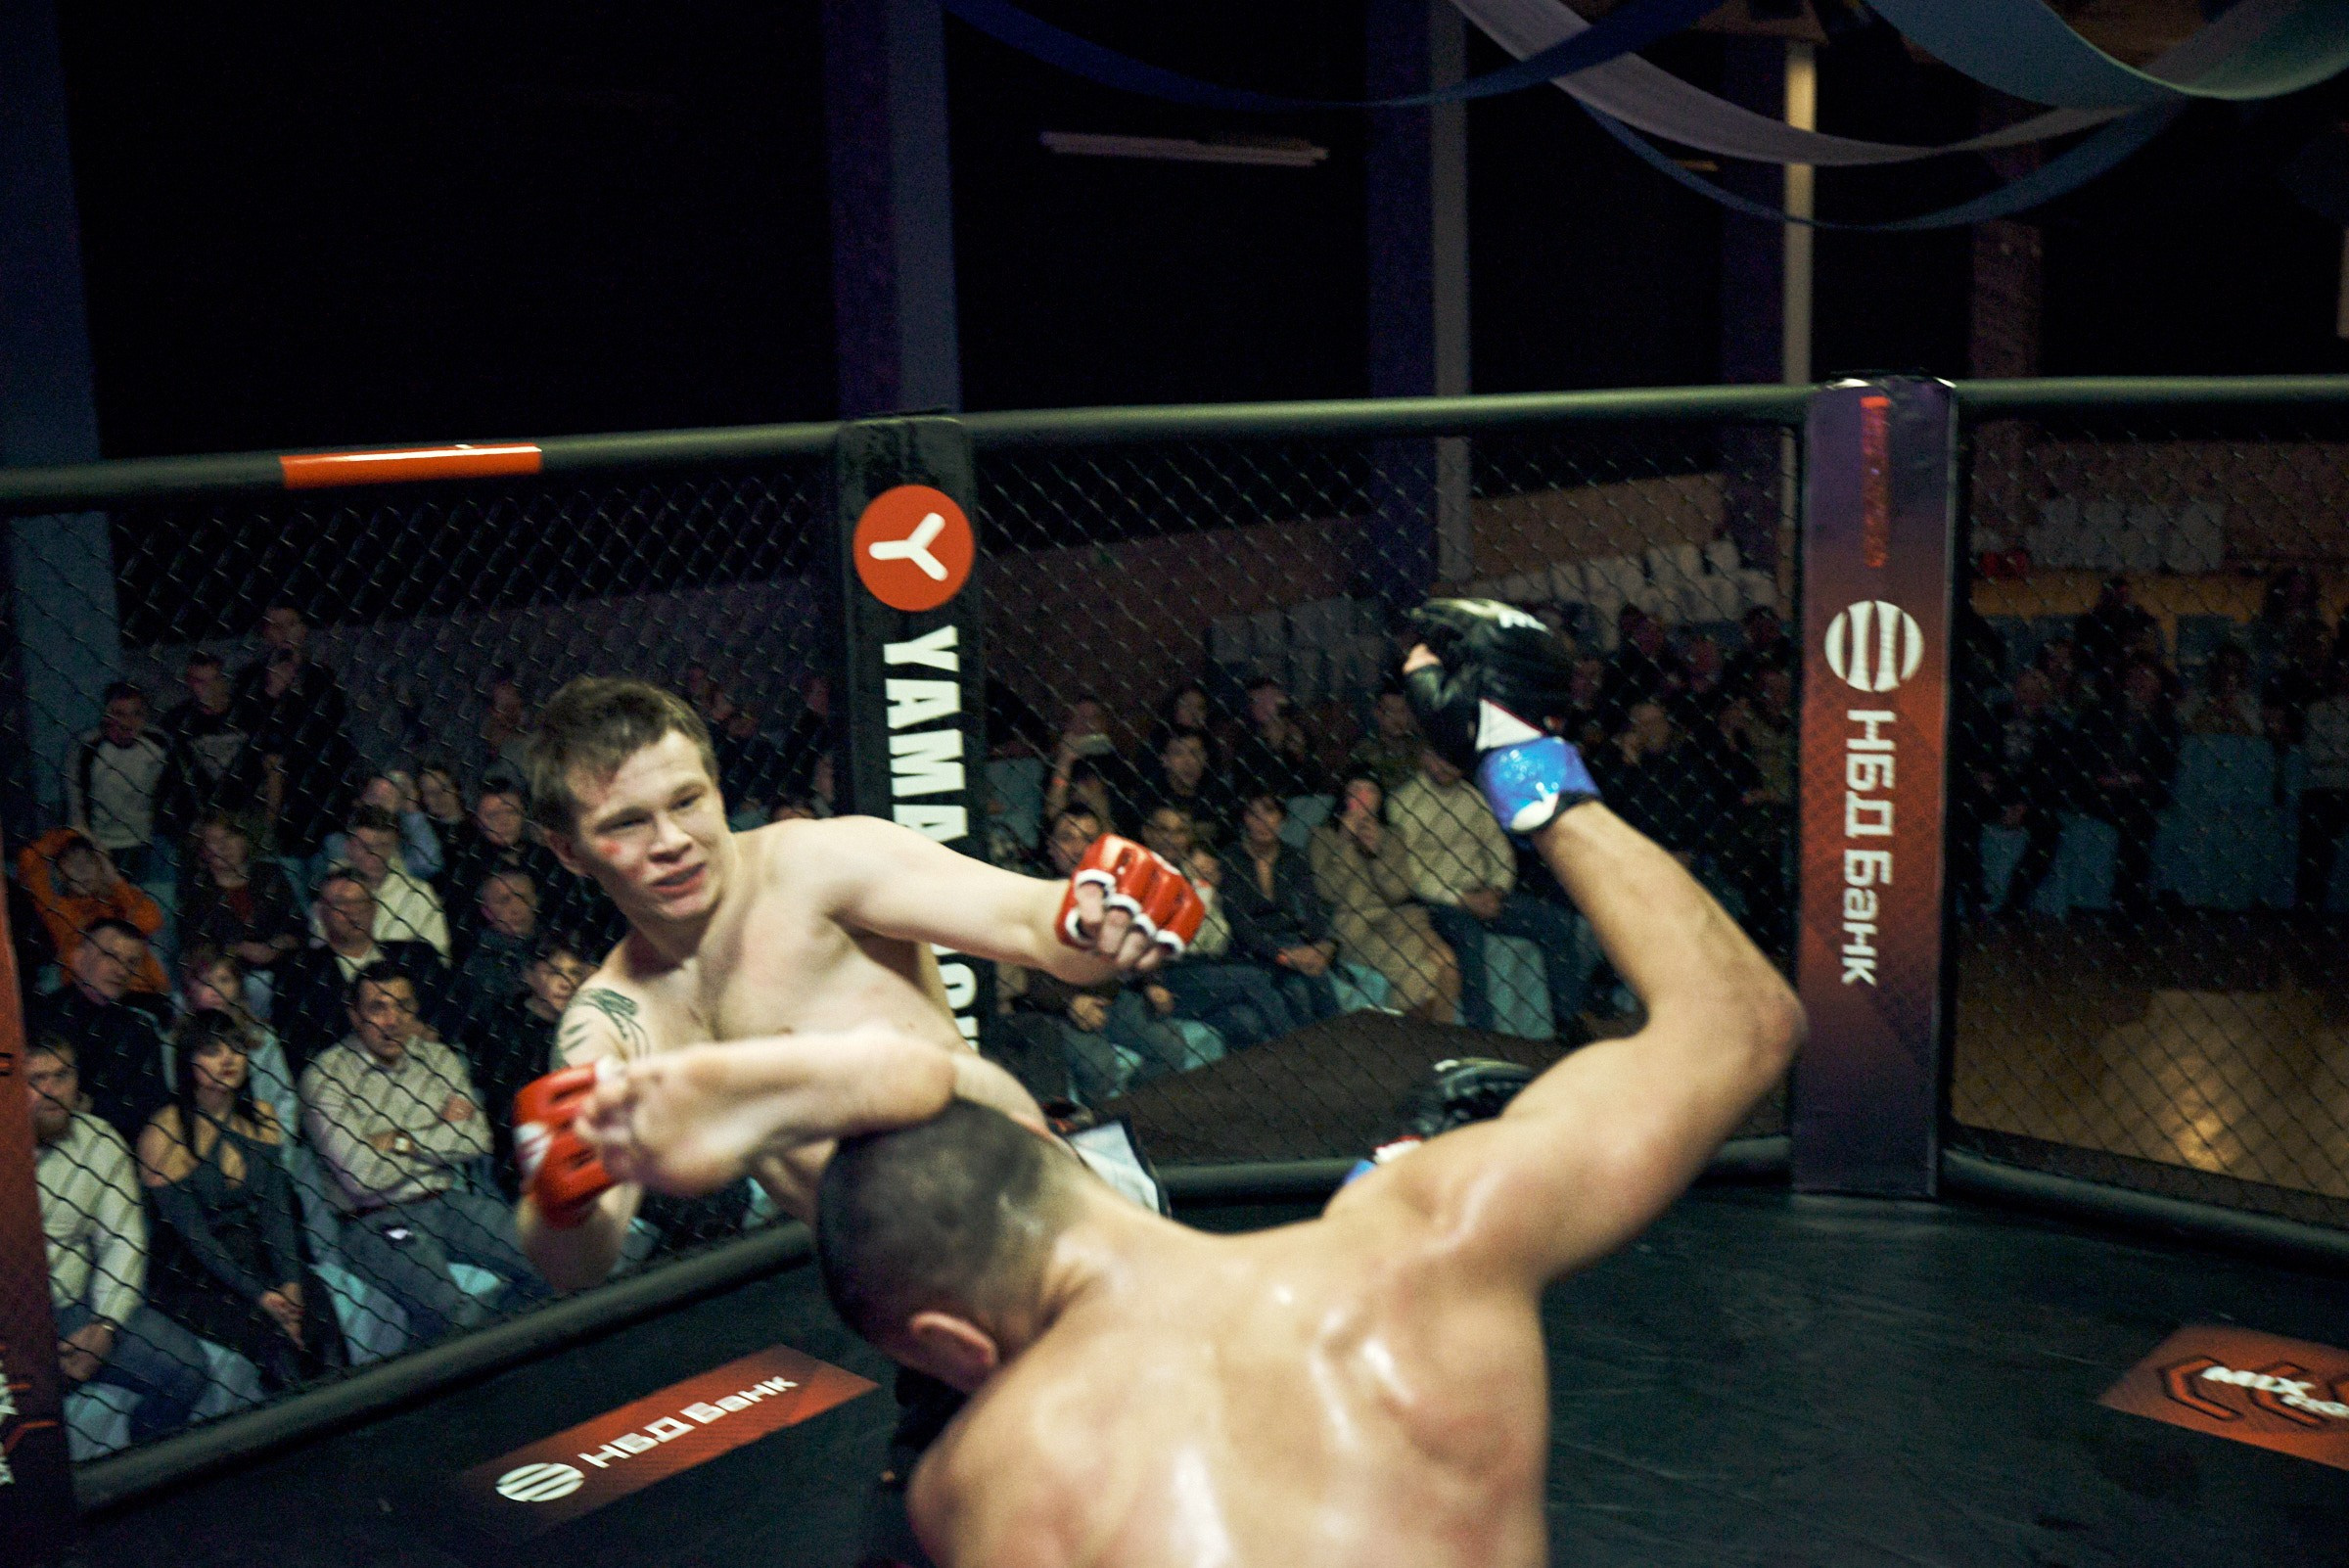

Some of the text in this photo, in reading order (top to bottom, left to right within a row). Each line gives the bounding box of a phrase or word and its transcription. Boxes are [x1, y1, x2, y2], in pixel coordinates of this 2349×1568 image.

[1841, 710, 1896, 986] НБД Банк
[577, 1375, 799, 1468] НБД Банк
